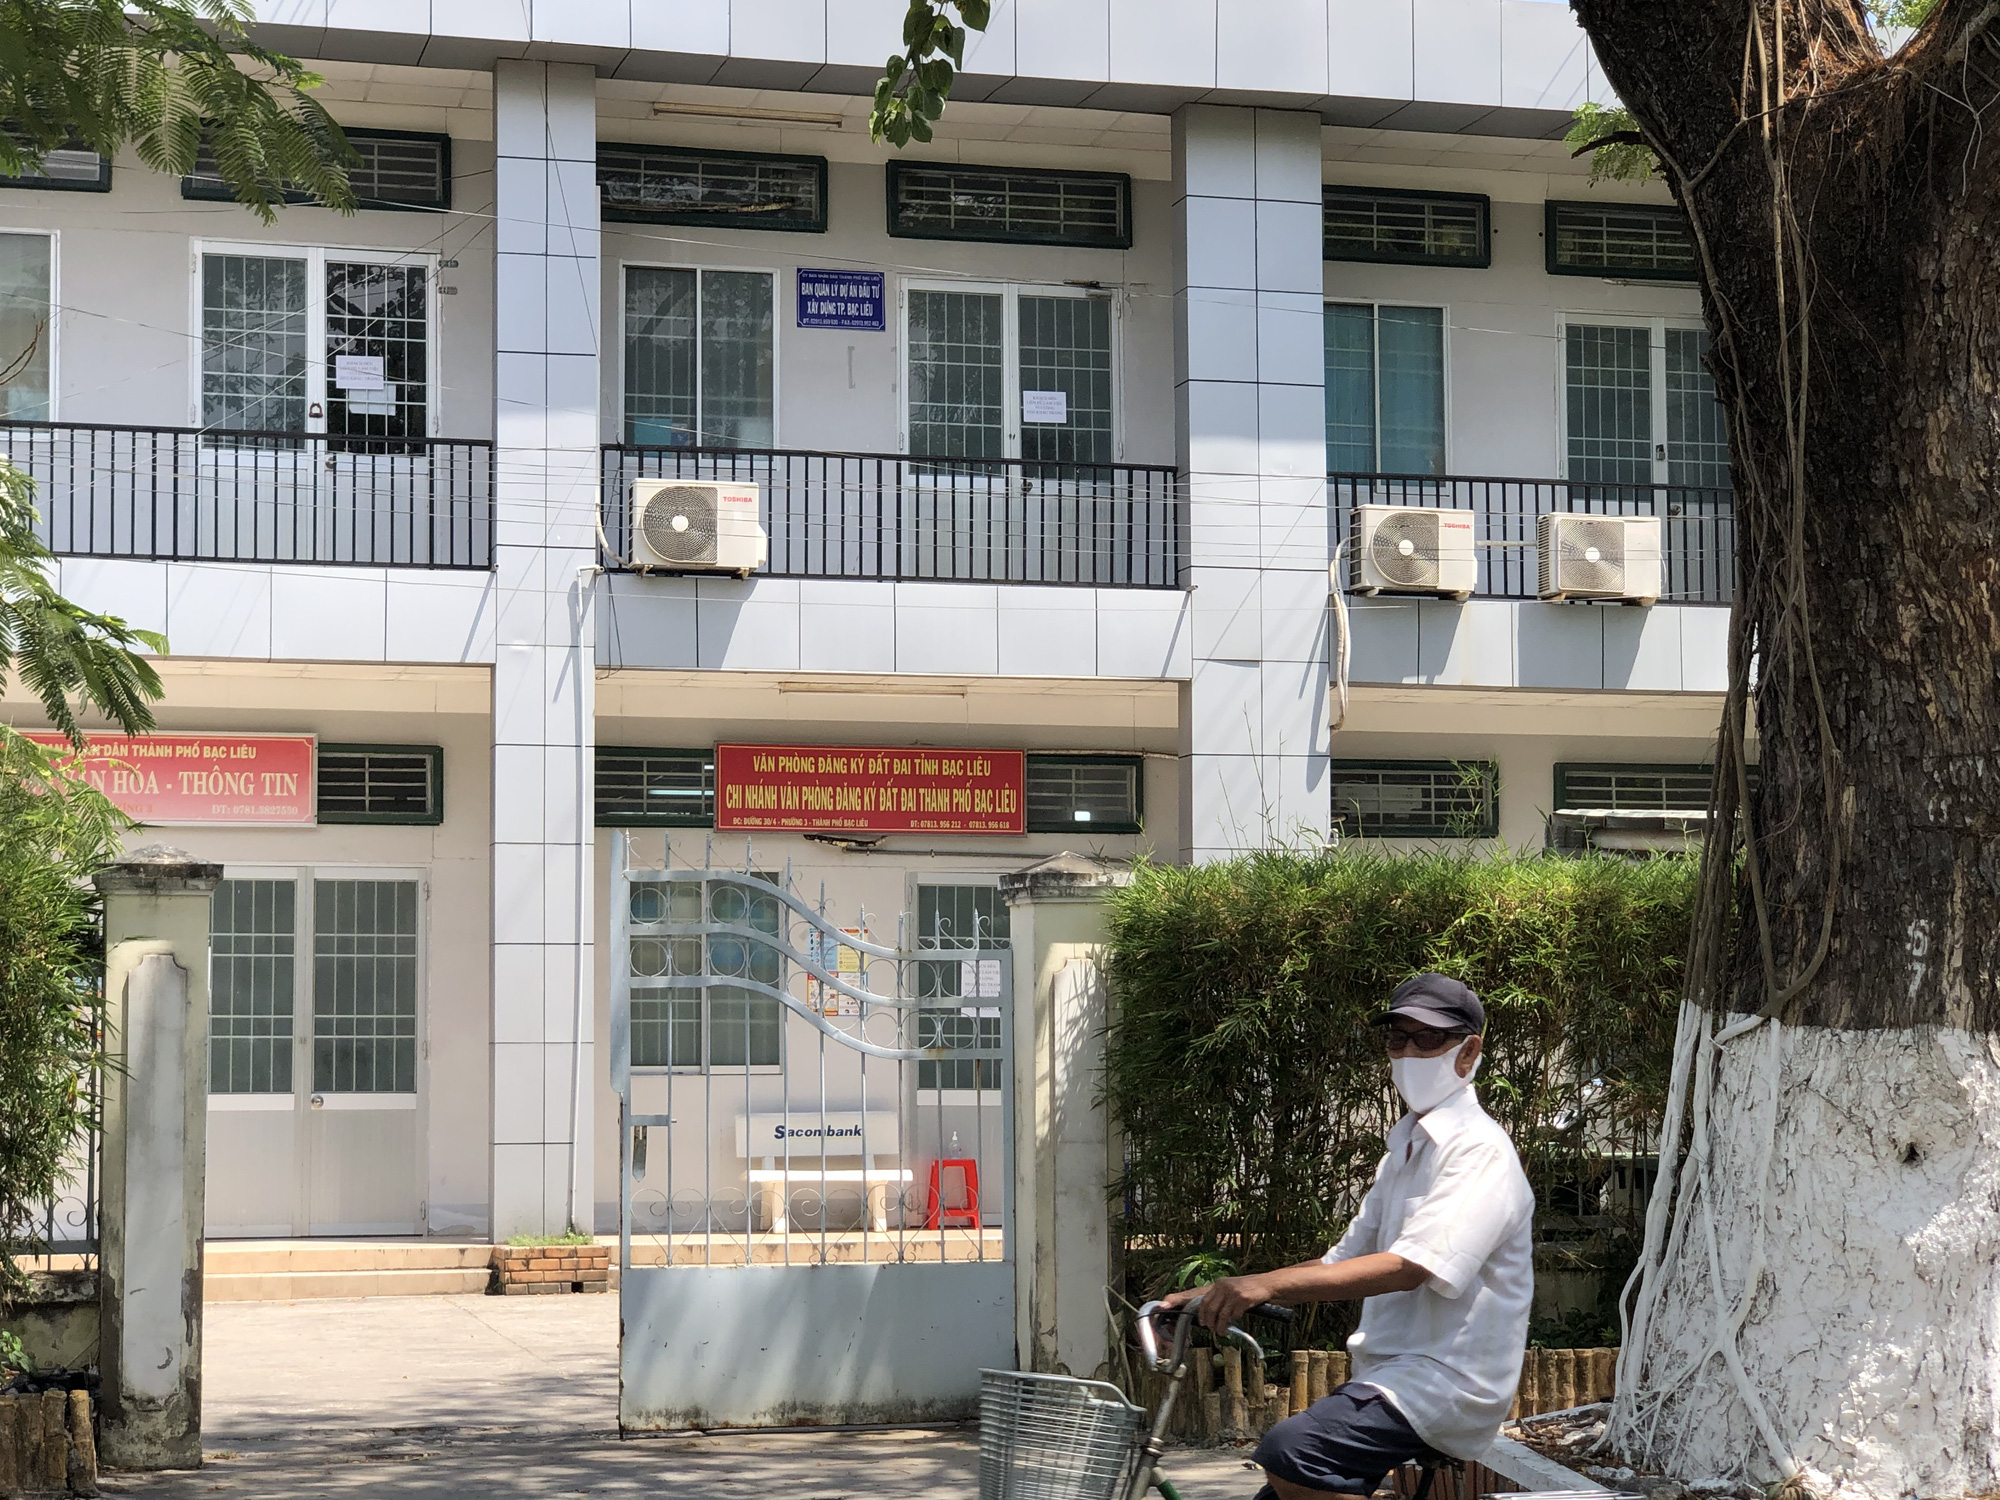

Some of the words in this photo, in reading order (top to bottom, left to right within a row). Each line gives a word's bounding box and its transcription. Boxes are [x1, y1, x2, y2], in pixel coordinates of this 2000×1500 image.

[801, 283, 813, 295] BAN
[815, 279, 830, 298] QUẢN
[831, 281, 838, 297] LÝ
[849, 282, 857, 297] ÁN
[871, 283, 880, 298] TƯ
[807, 298, 819, 314] XÂY
[820, 299, 836, 317] DỰNG
[837, 302, 846, 315] TP.
[847, 303, 859, 318] BẠC
[860, 301, 873, 316] LIÊU
[104, 742, 128, 757] DÂN
[132, 742, 172, 757] THÀNH
[176, 741, 200, 758] PHỐ
[203, 745, 227, 761] BẠC
[231, 744, 256, 759] LIÊU
[753, 752, 775, 772] VĂN
[779, 752, 815, 773] PHÒNG
[818, 753, 847, 774] ĐĂNG
[850, 753, 865, 774] KÝ
[868, 752, 890, 774] ĐẤT
[893, 758, 911, 775] ĐAI
[914, 753, 939, 775] TỈNH
[942, 759, 964, 779] BẠC
[967, 755, 991, 776] LIÊU
[112, 763, 159, 794] HÓA
[178, 765, 255, 796] THÔNG
[261, 772, 298, 796] TIN
[726, 784, 742, 809] CHI
[745, 778, 777, 809] NHÁNH
[780, 780, 799, 810] VĂN
[802, 779, 833, 811] PHÒNG
[836, 782, 861, 811] ĐĂNG
[864, 780, 876, 811] KÝ
[880, 777, 898, 811] ĐẤT
[901, 787, 916, 812] ĐAI
[919, 781, 950, 812] THÀNH
[953, 779, 973, 812] PHỐ
[974, 788, 993, 818] BẠC
[995, 783, 1017, 813] LIÊU
[763, 817, 776, 826] 30/4
[951, 821, 961, 829] 212
[774, 1124, 862, 1139] Sacombank
